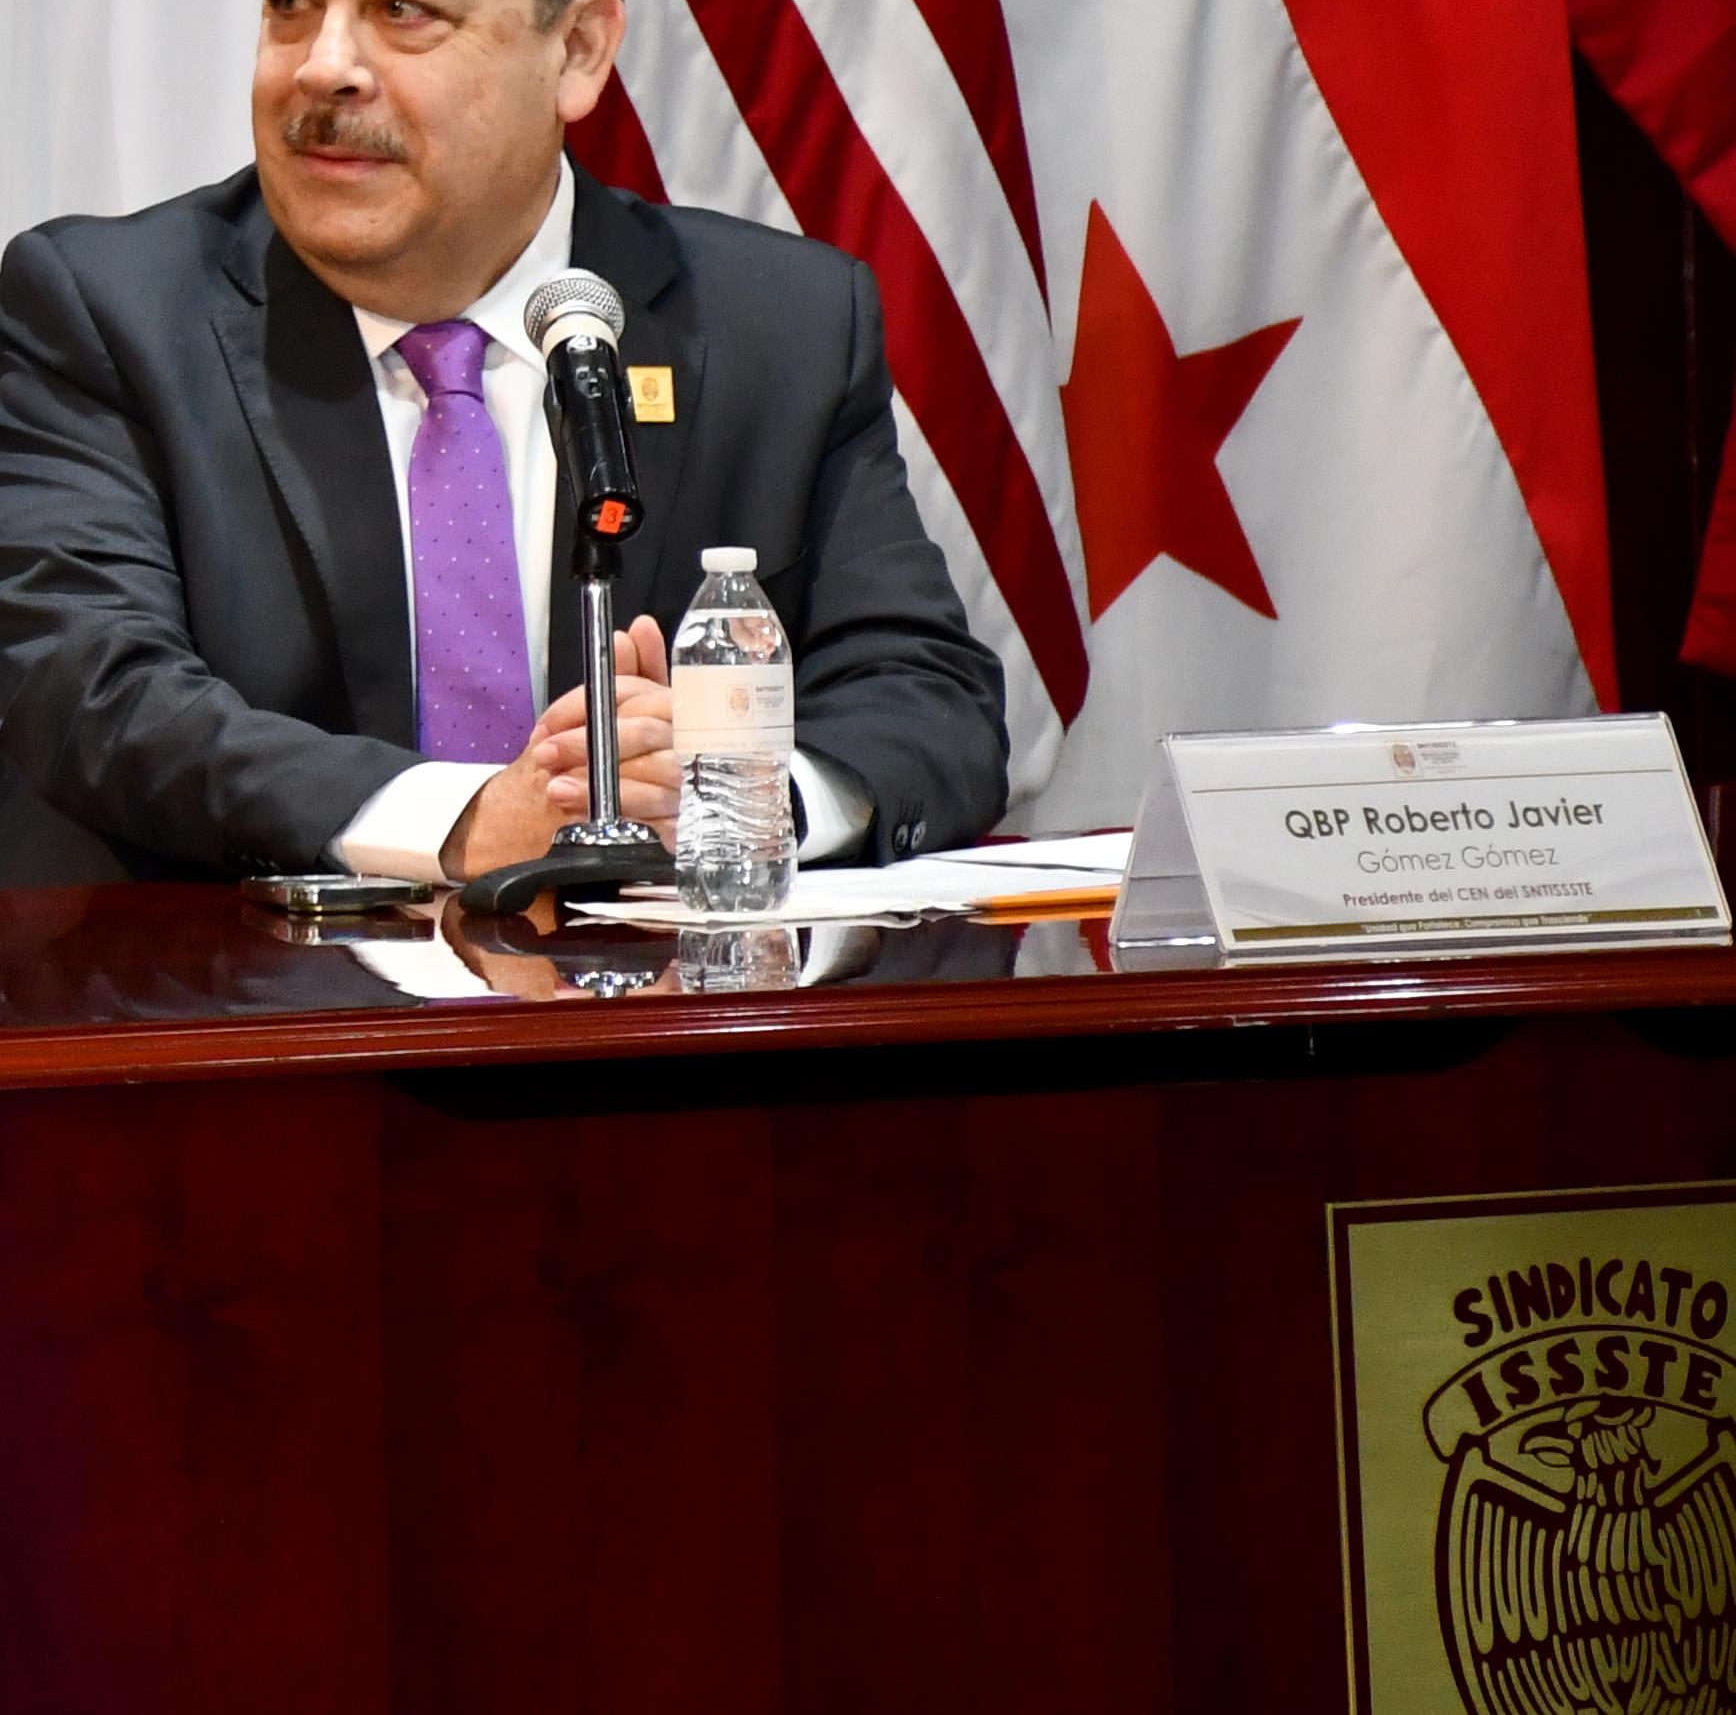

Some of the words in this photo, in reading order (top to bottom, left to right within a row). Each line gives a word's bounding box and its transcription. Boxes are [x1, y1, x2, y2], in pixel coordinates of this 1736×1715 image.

[1284, 807, 1351, 841] QBP
[1364, 801, 1495, 836] Roberto
[1508, 796, 1604, 828] Javier
[1357, 846, 1455, 875] Gómez
[1461, 842, 1560, 871] Gómez
[1342, 889, 1424, 909] Presidente
[1428, 887, 1454, 904] del
[1457, 886, 1490, 902] CEN
[1494, 884, 1519, 901] del
[1521, 881, 1595, 899] SNTISSSTE
[1453, 1256, 1728, 1348] SINDICATO
[1461, 1335, 1723, 1428] ISSSTE
